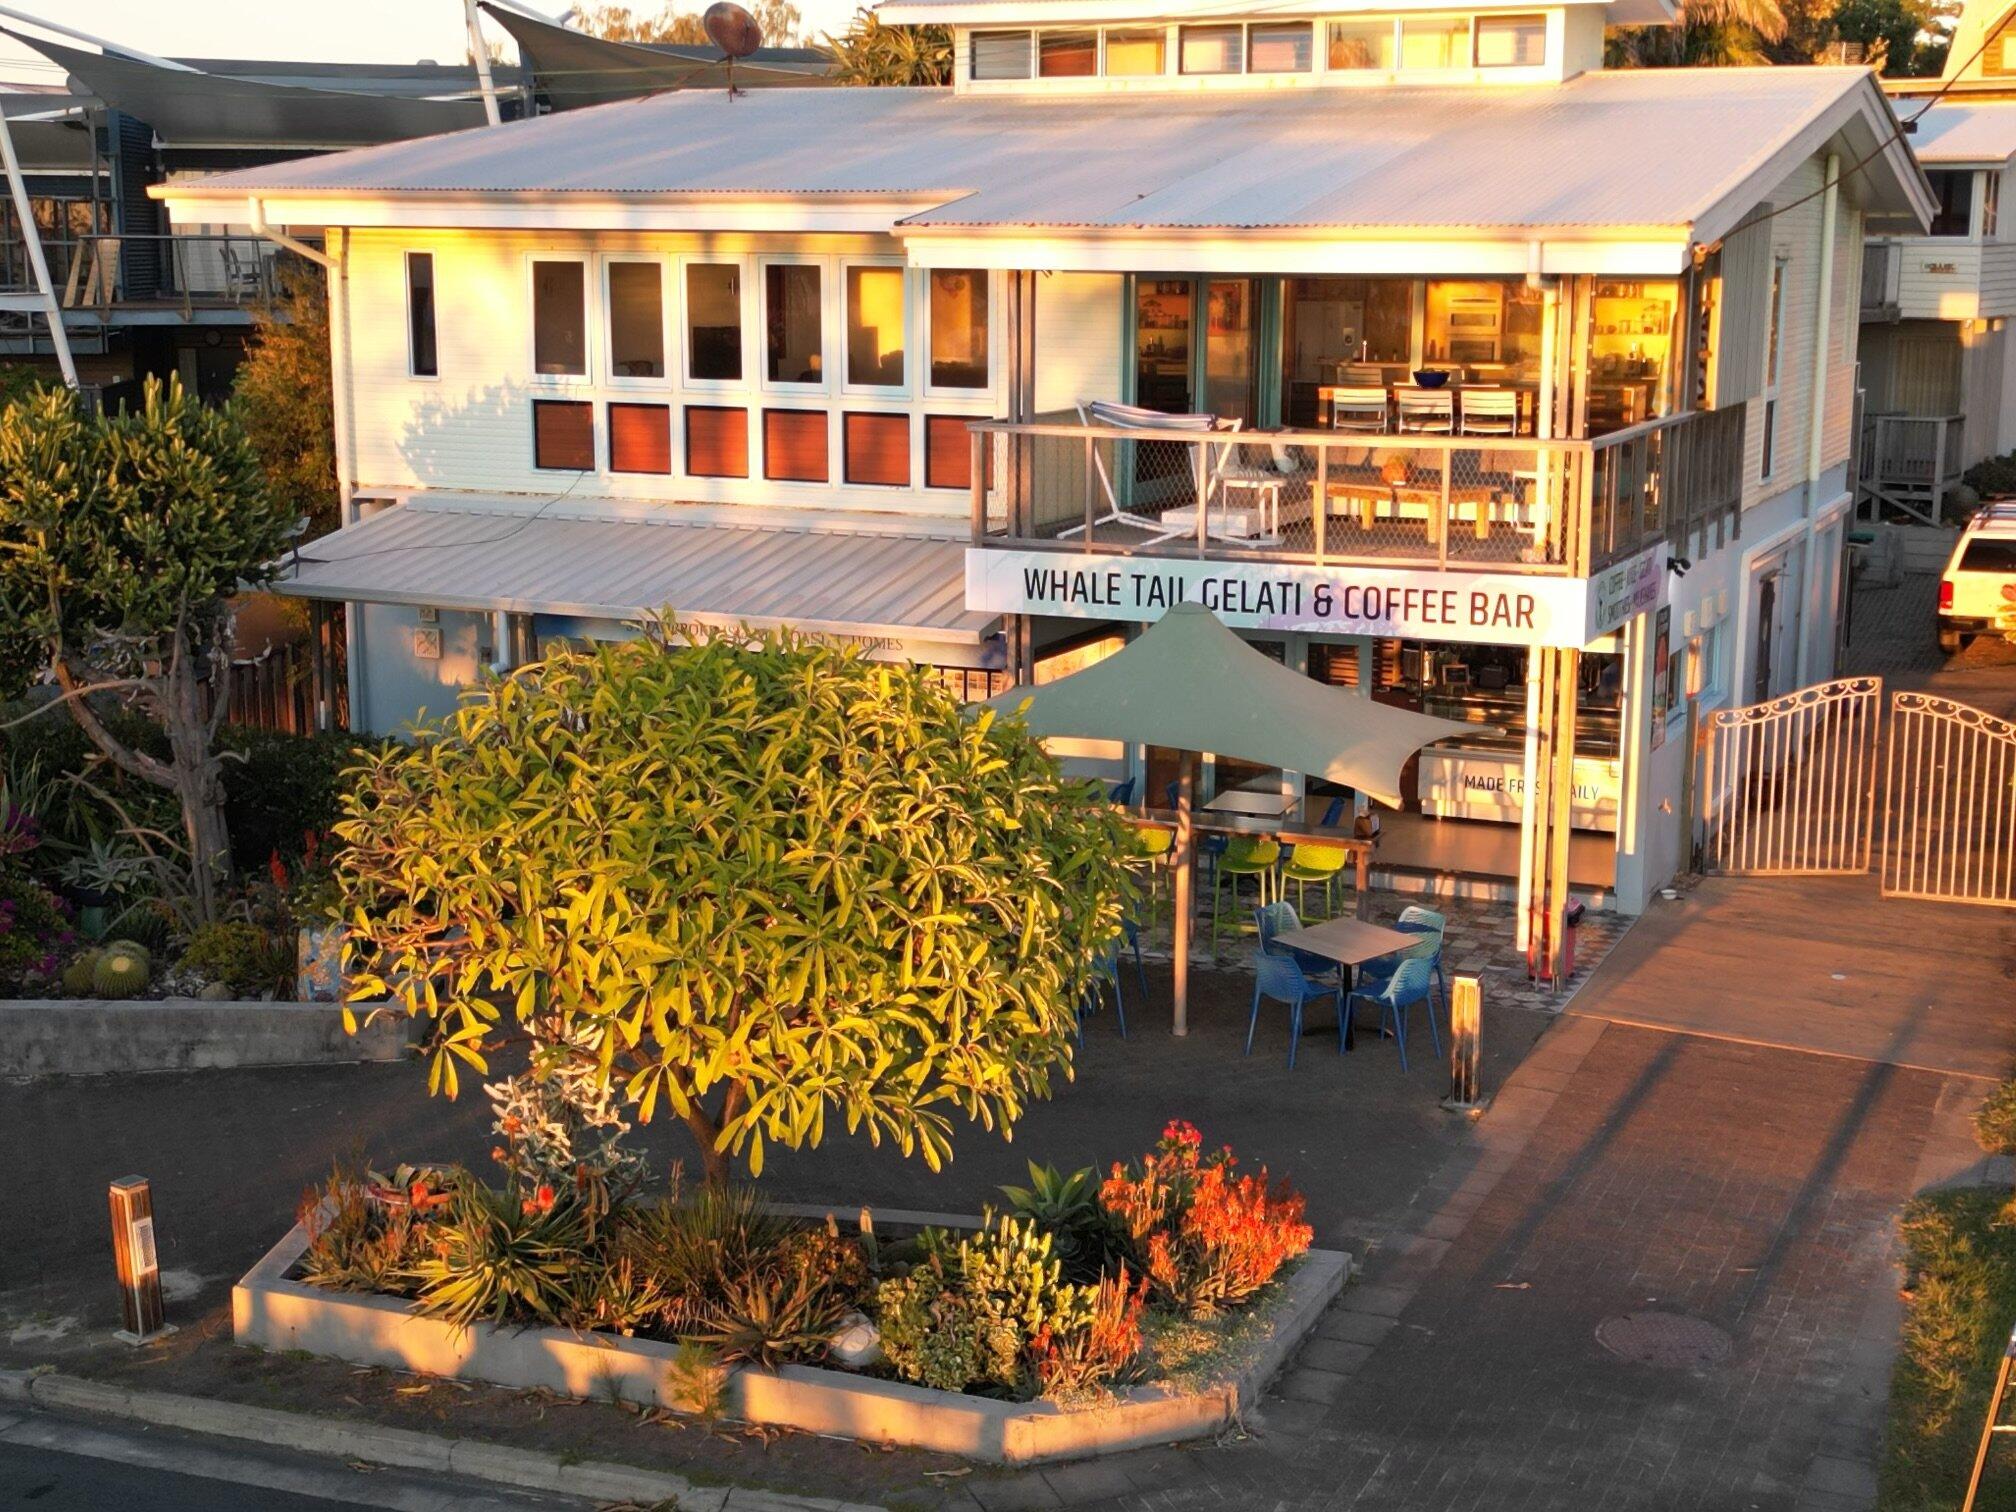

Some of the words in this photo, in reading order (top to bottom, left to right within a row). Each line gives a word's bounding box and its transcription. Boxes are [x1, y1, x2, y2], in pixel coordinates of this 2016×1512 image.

[1024, 568, 1121, 605] WHALE
[1202, 578, 1301, 615] GELATI
[1313, 584, 1334, 617] &
[1344, 585, 1458, 624] COFFEE
[1470, 591, 1535, 629] BAR
[852, 635, 904, 651] HOMES
[1464, 775, 1504, 792] MADE
[1571, 783, 1599, 800] AILY
